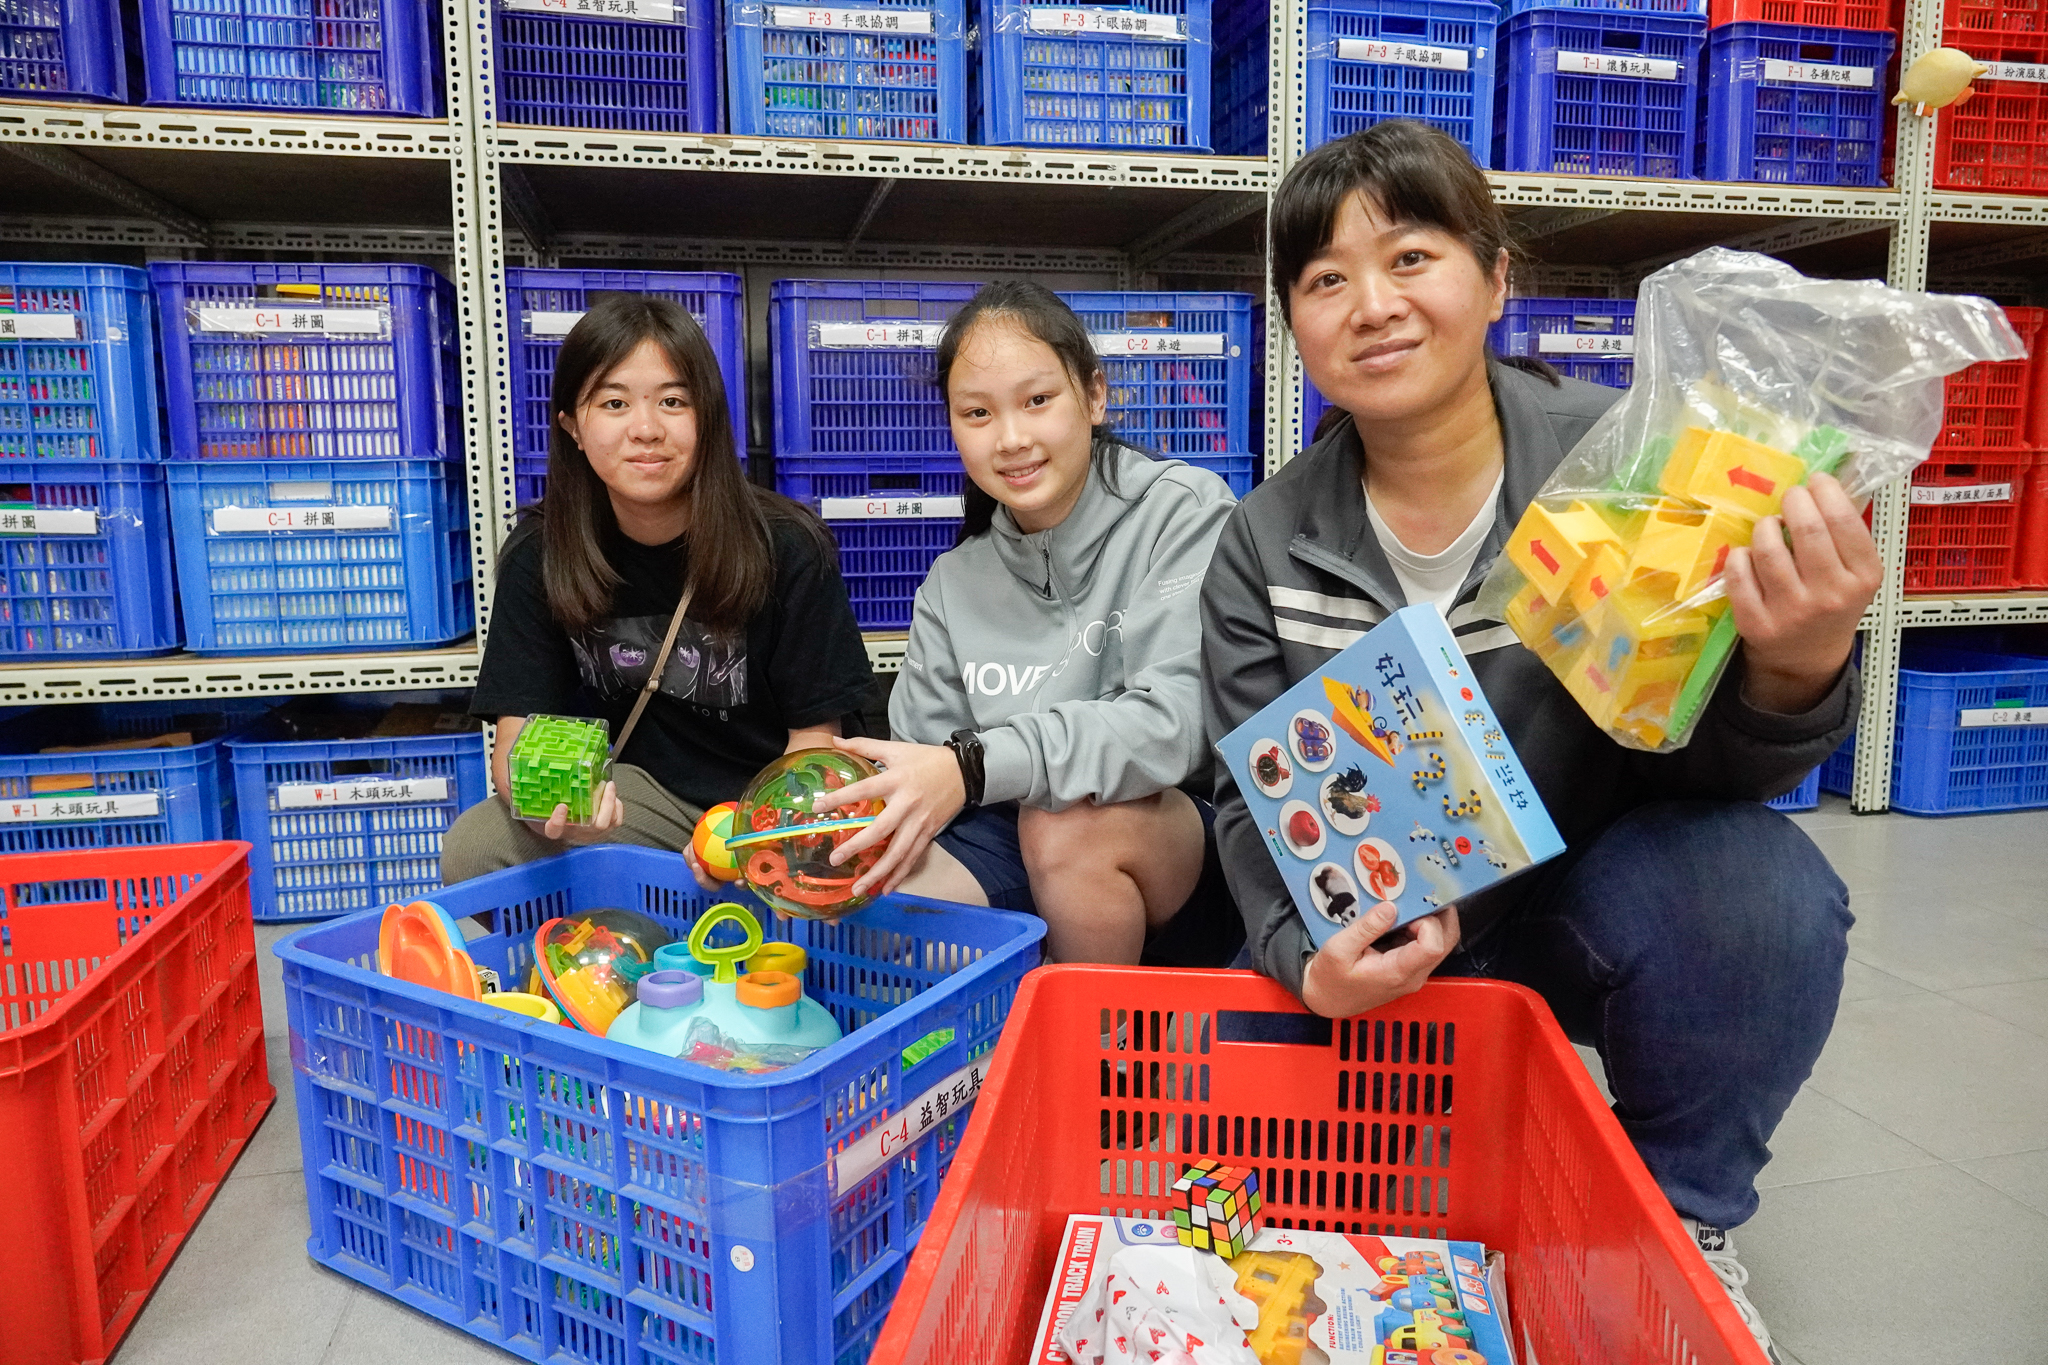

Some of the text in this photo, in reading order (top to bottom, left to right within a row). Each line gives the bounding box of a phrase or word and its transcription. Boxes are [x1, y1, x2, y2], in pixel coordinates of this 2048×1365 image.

[808, 12, 899, 30] F-3 手眼協調
[1062, 12, 1148, 32] F-3 手眼協調
[1366, 43, 1442, 65] F-3 手眼協調
[1582, 56, 1652, 75] T-1 懷舊玩具
[1988, 64, 1998, 76] 31
[1788, 66, 1852, 82] F-1 各種陀螺
[1, 319, 16, 334] 圖
[256, 314, 324, 330] C-1 拼圖
[866, 328, 924, 343] C-1 拼圖
[1128, 338, 1182, 352] C-2 桌遊
[1576, 338, 1622, 351] C-2 桌遊
[1916, 490, 1936, 501] S-31
[866, 502, 923, 516] C-1 拼圖
[1, 513, 36, 530] 拼圖
[268, 511, 335, 526] C-1 拼圖
[962, 609, 1128, 696] MOVE SPOR
[1992, 712, 2008, 722] C-2
[314, 785, 414, 801] W-1 木頭玩具
[12, 800, 120, 818] W-1 木頭玩具
[880, 1067, 984, 1158] C-4 益智玩具
[1072, 1226, 1097, 1259] TRAIN
[1062, 1260, 1088, 1298] TRACK
[1328, 1314, 1336, 1349] FUNCTION:
